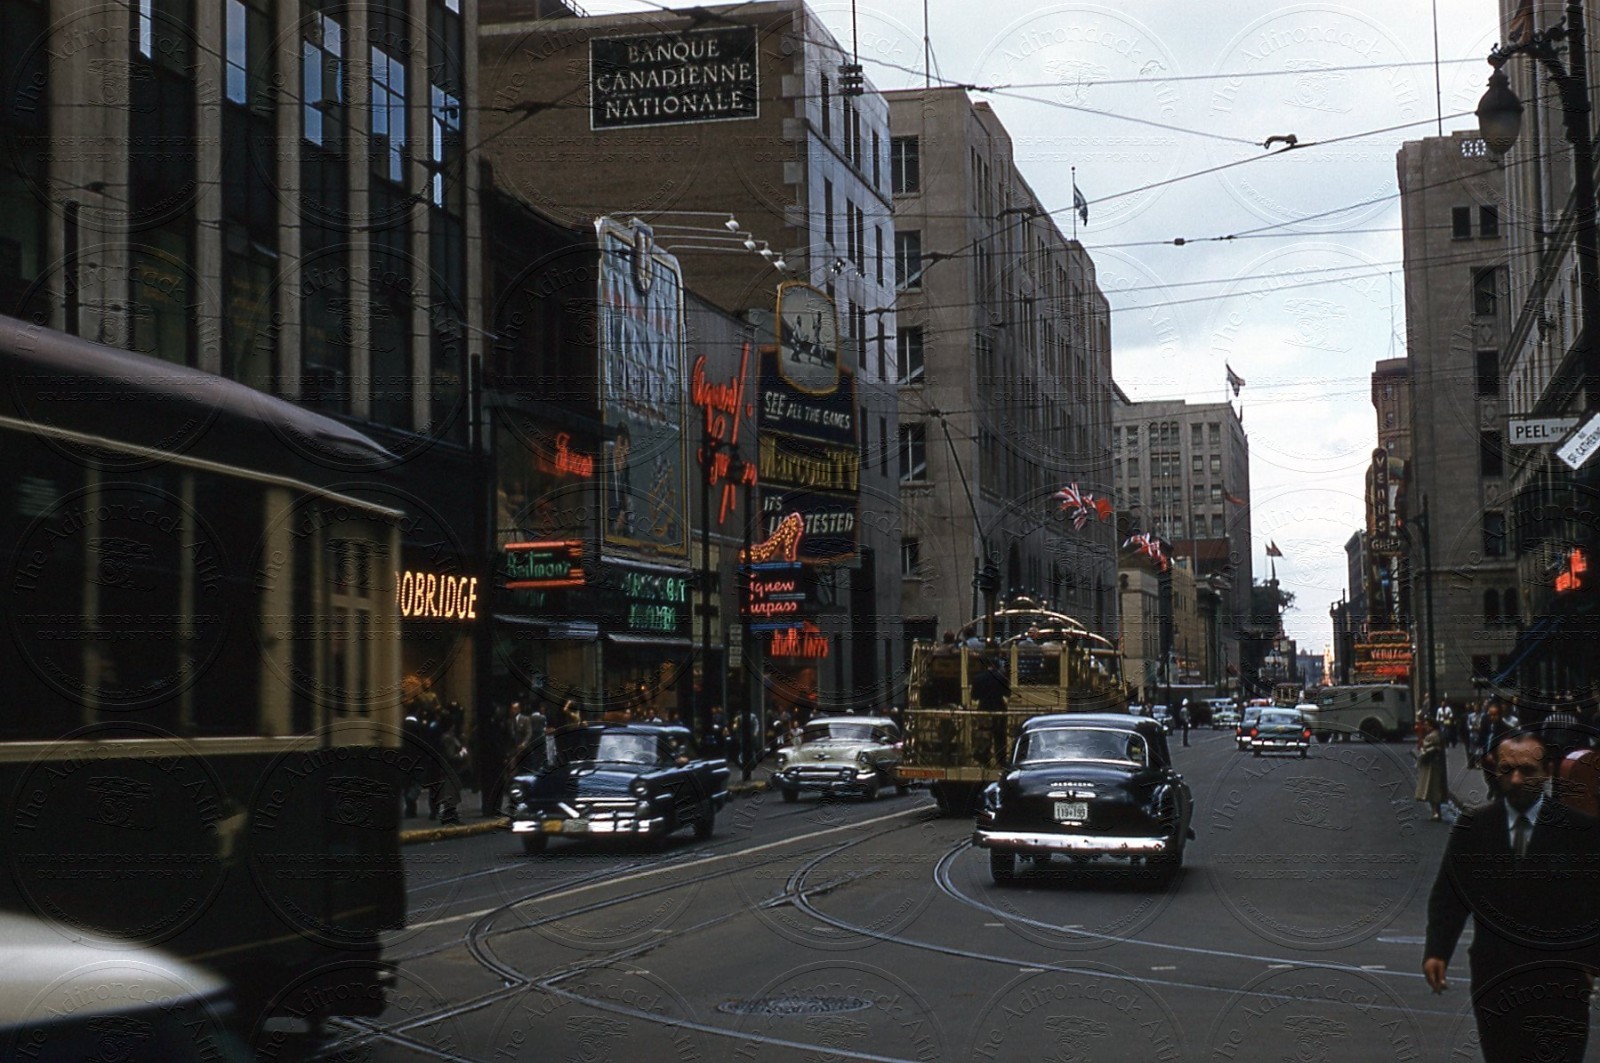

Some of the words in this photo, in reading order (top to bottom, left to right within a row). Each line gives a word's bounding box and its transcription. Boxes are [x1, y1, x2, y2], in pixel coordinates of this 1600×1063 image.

[628, 39, 720, 63] BANQUE
[596, 62, 752, 92] CANADIENNE
[605, 91, 744, 119] NATIONALE
[764, 391, 787, 415] SEE
[786, 403, 802, 420] ALL
[805, 406, 821, 424] THE
[823, 410, 851, 430] GAMES
[1515, 424, 1549, 439] PEEL
[1375, 456, 1387, 532] VENUS
[804, 512, 854, 534] TESTED
